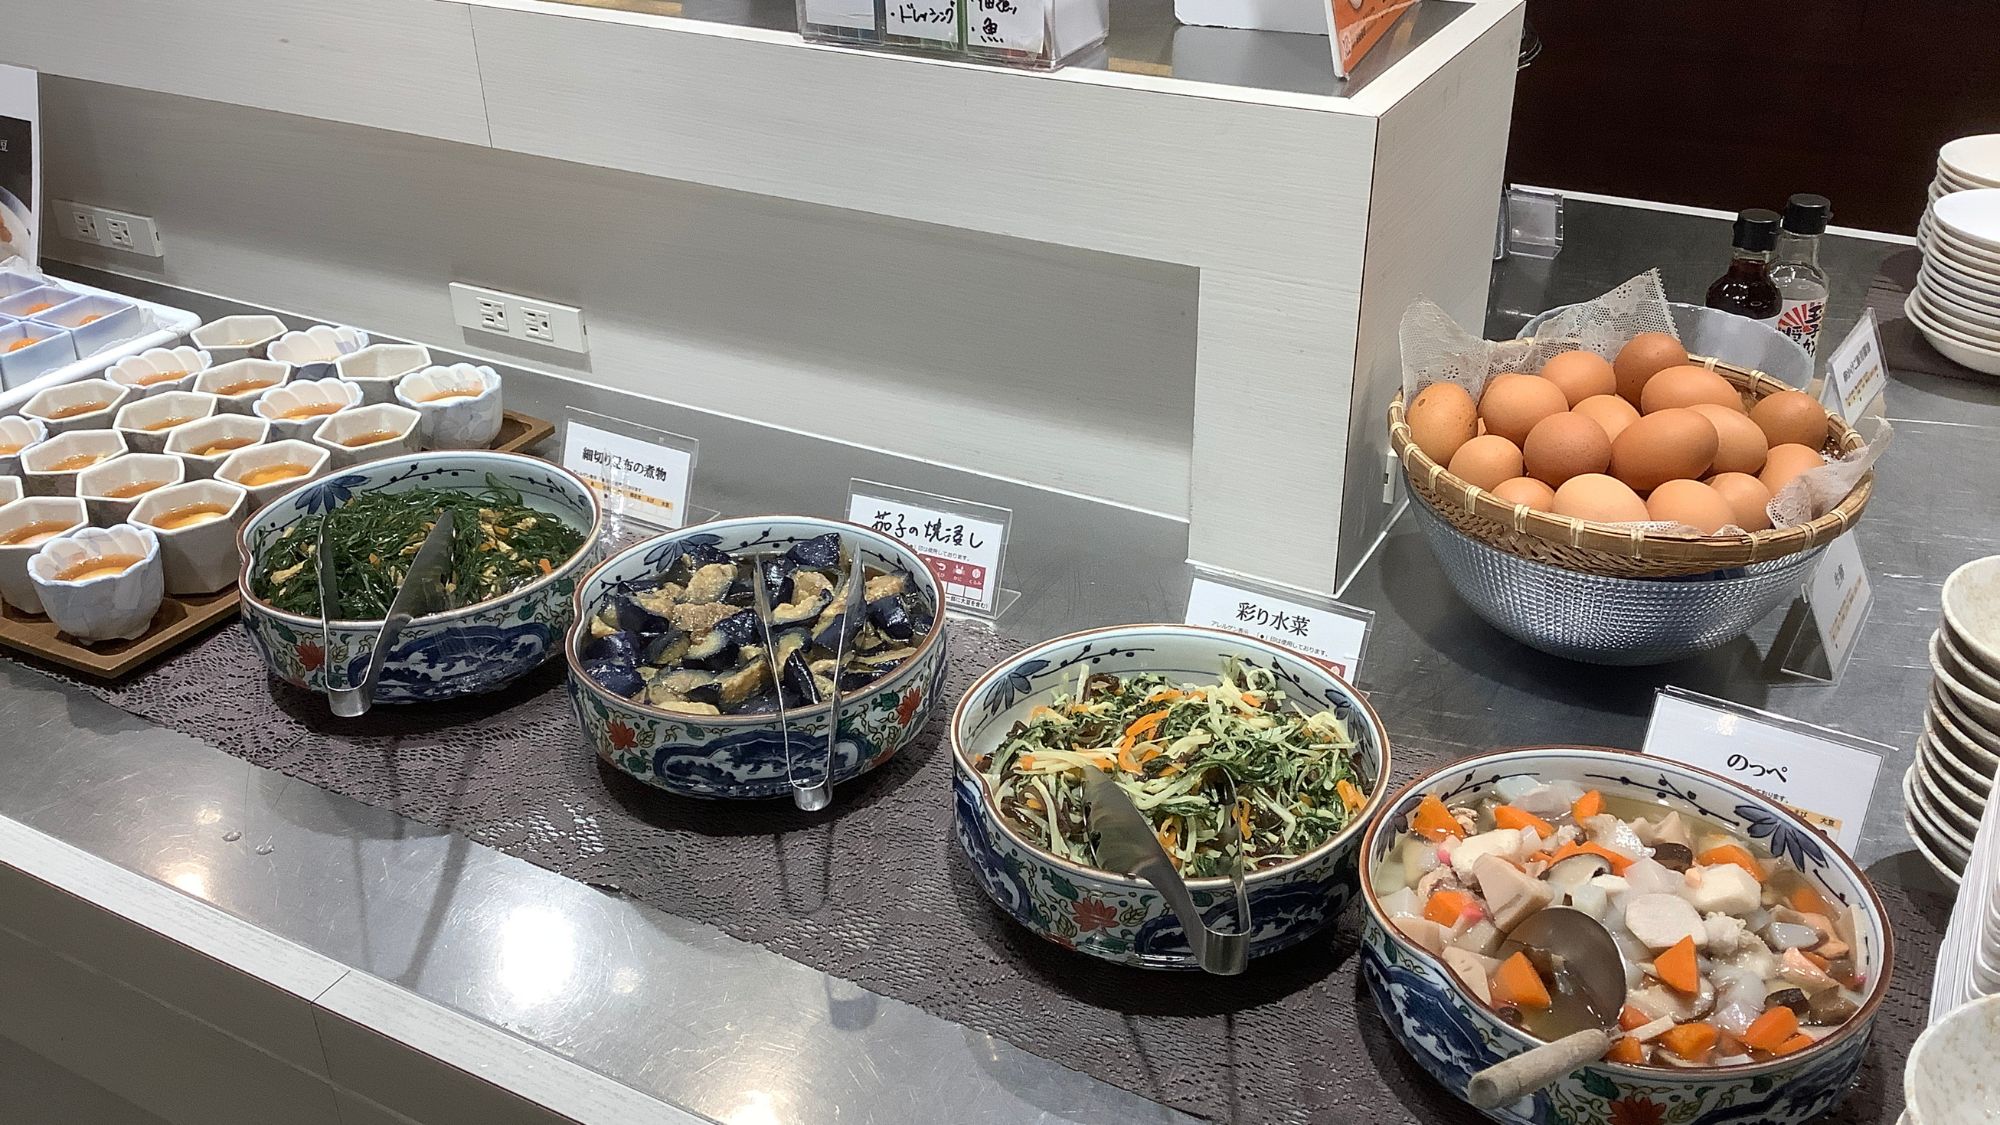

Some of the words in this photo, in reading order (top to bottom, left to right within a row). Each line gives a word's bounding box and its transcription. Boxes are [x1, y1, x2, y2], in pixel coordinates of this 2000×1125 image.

[1236, 602, 1311, 637] 彩り水菜
[1726, 753, 1788, 783] のっぺ
